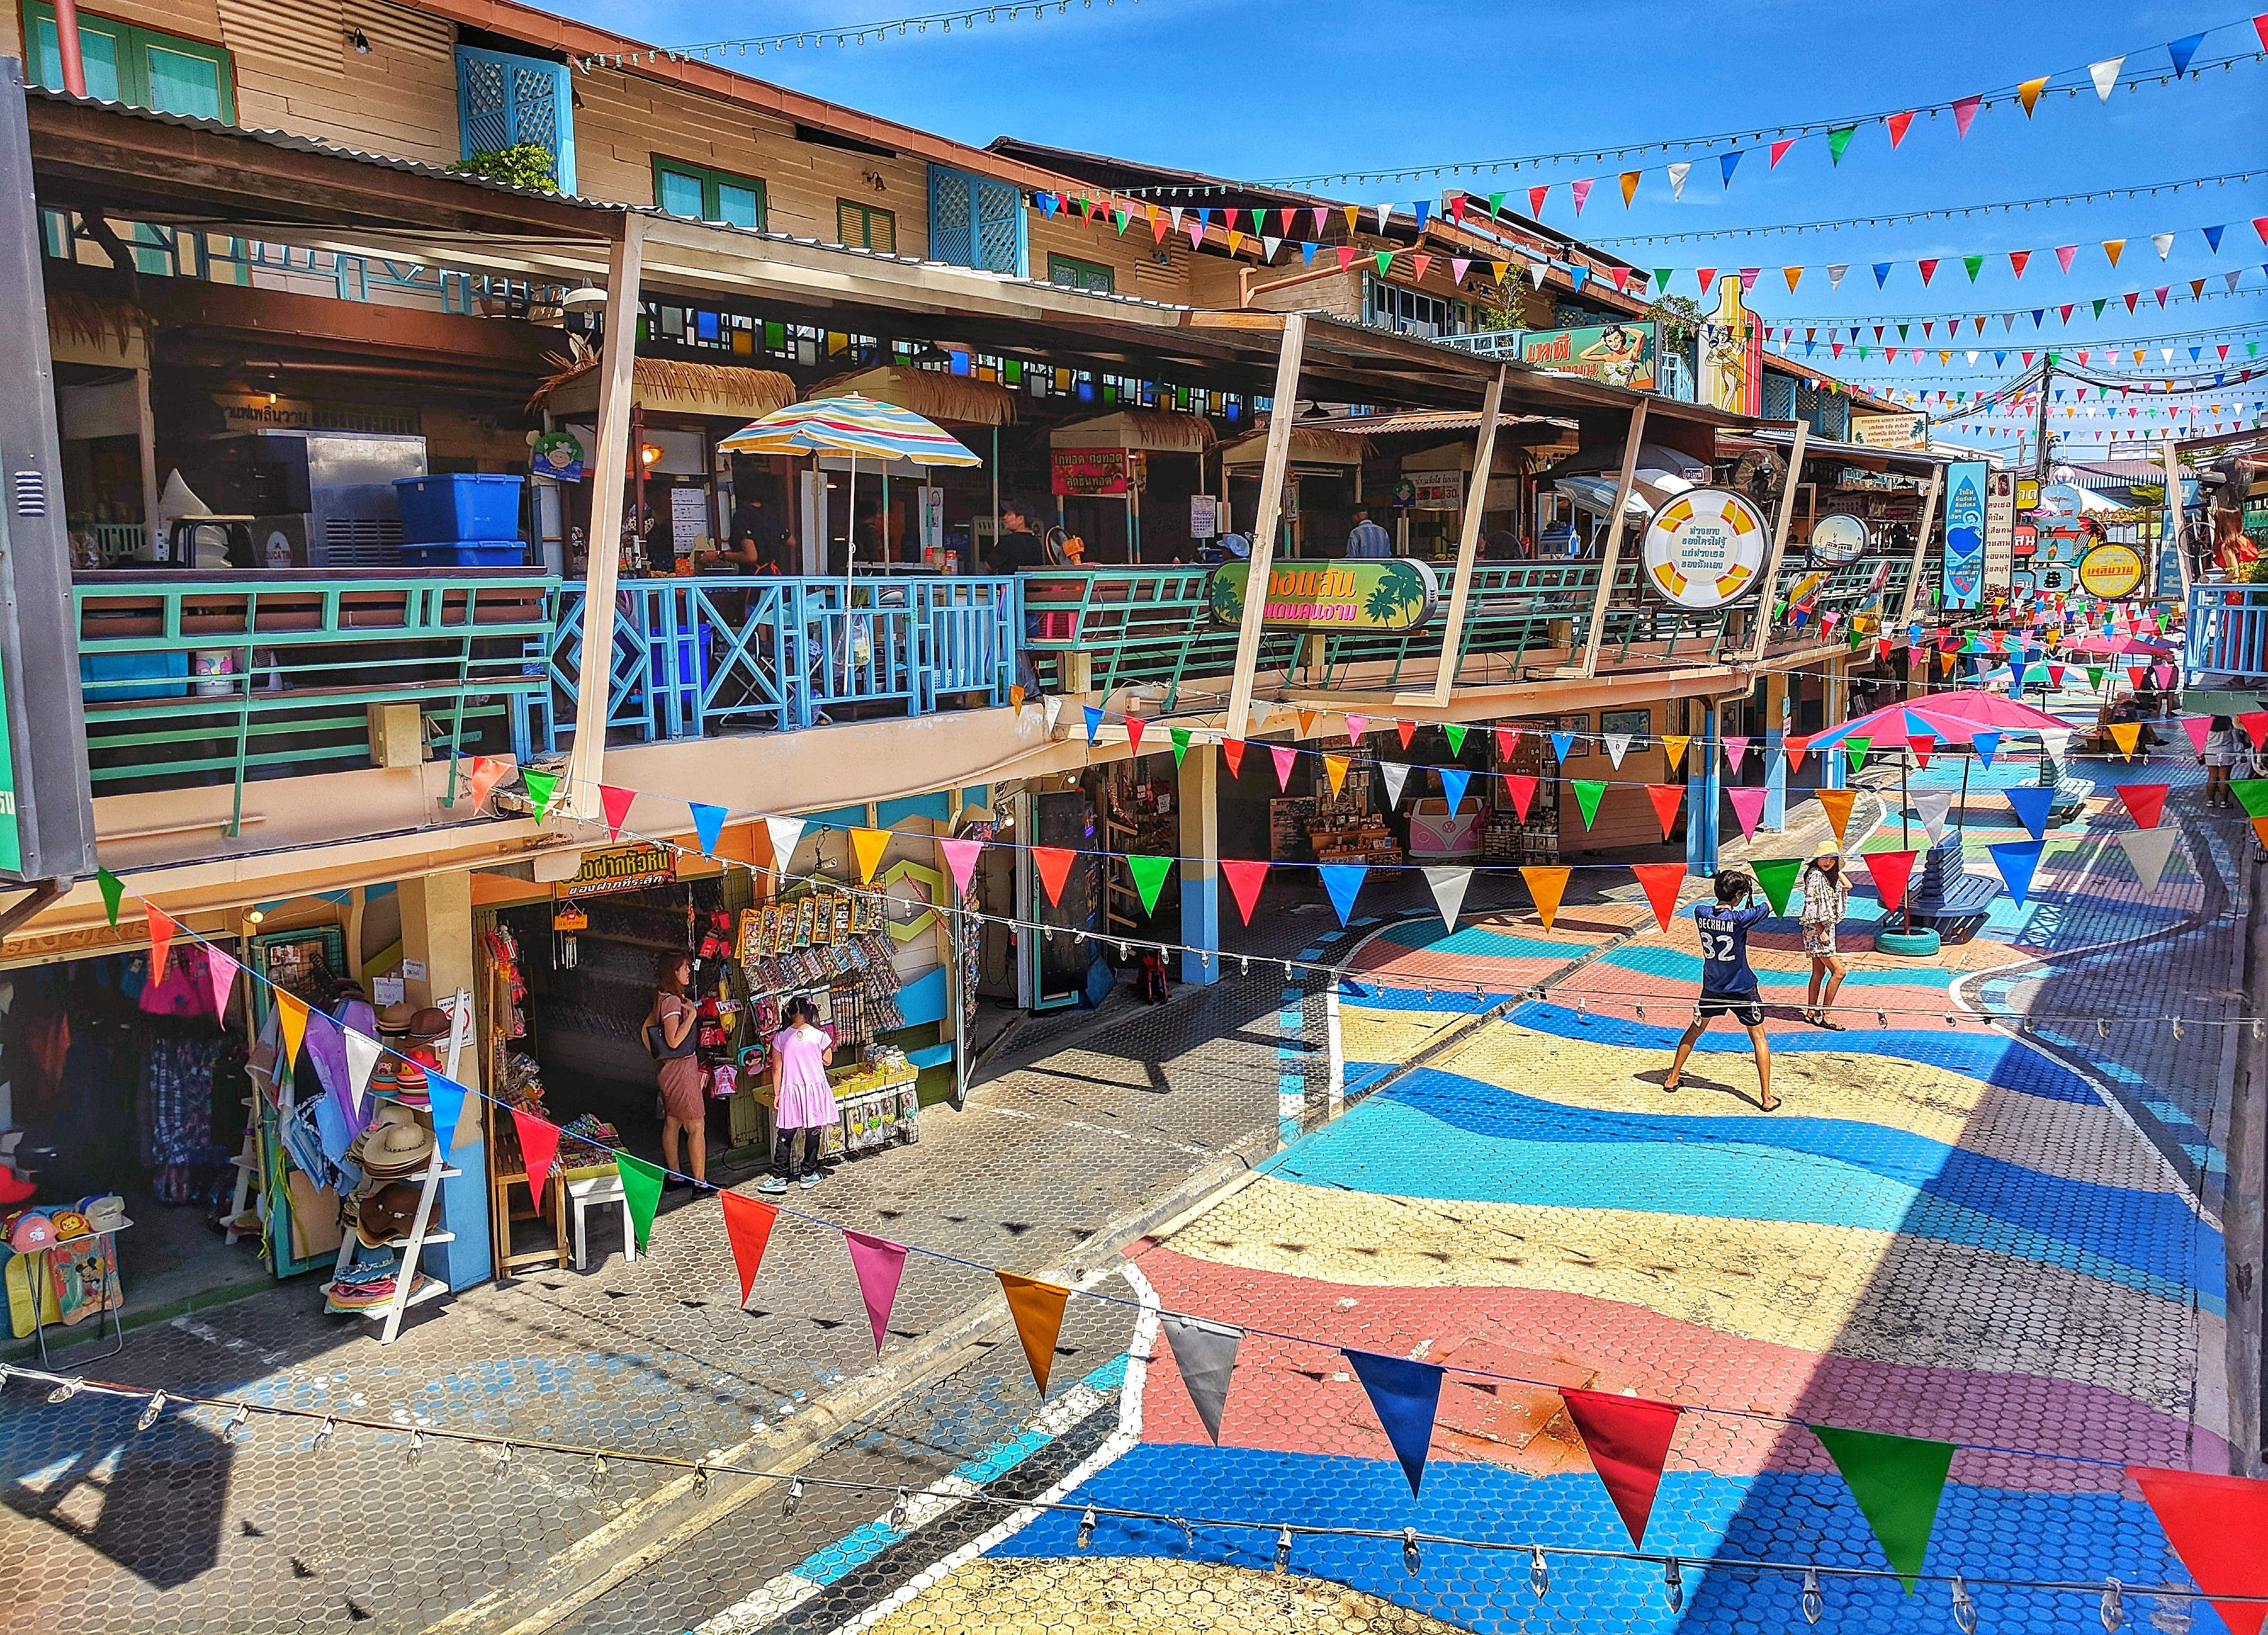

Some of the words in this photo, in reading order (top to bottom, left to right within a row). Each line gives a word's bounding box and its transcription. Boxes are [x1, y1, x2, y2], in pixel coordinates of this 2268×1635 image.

[1527, 333, 1571, 362] เทพี
[1089, 451, 1123, 468] กุ้งทอด
[1067, 472, 1113, 491] ลูกชิ้นทอด
[1446, 488, 1457, 499] 30
[2017, 488, 2038, 501] าด
[1690, 526, 1719, 535] ห่วงยาง
[1682, 535, 1727, 548] ของใครไม่รู้
[2015, 535, 2035, 547] สน
[1681, 548, 1725, 558] แต่ห่วงเธอ
[1681, 558, 1723, 569] ของฉันเอง
[1985, 564, 2009, 574] ยู่ชลบุรี
[2088, 565, 2134, 575] เพลินวาน
[1269, 568, 1357, 598] างแสน
[574, 850, 668, 882] องฝากหัวหิน
[569, 875, 663, 895] ของฝากที่ระลึก
[1699, 917, 1733, 933] BECKHAM
[1700, 931, 1735, 961] 32
